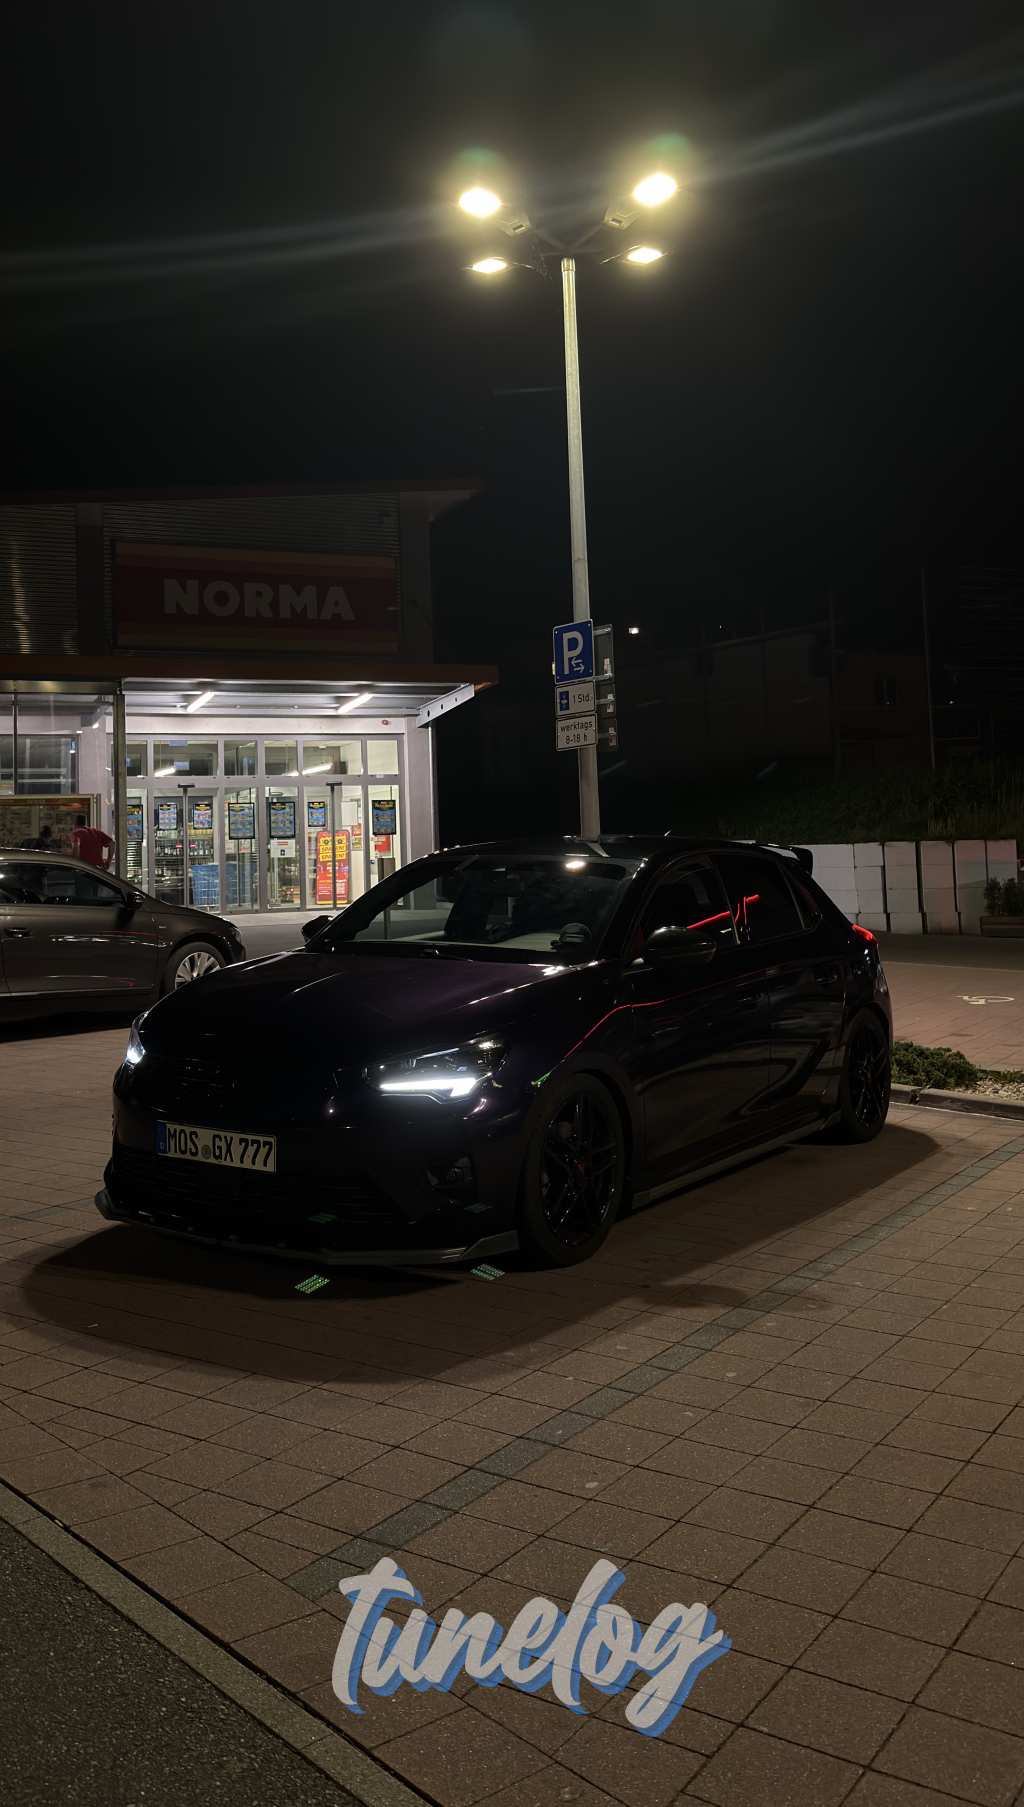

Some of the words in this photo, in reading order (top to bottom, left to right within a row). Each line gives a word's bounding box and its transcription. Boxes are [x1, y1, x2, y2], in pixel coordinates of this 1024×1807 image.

[163, 578, 356, 621] NORMA
[563, 631, 584, 675] P
[560, 720, 593, 733] werktags
[584, 732, 588, 743] h
[167, 1127, 199, 1157] MOS
[212, 1134, 234, 1162] GX
[239, 1137, 273, 1168] 777
